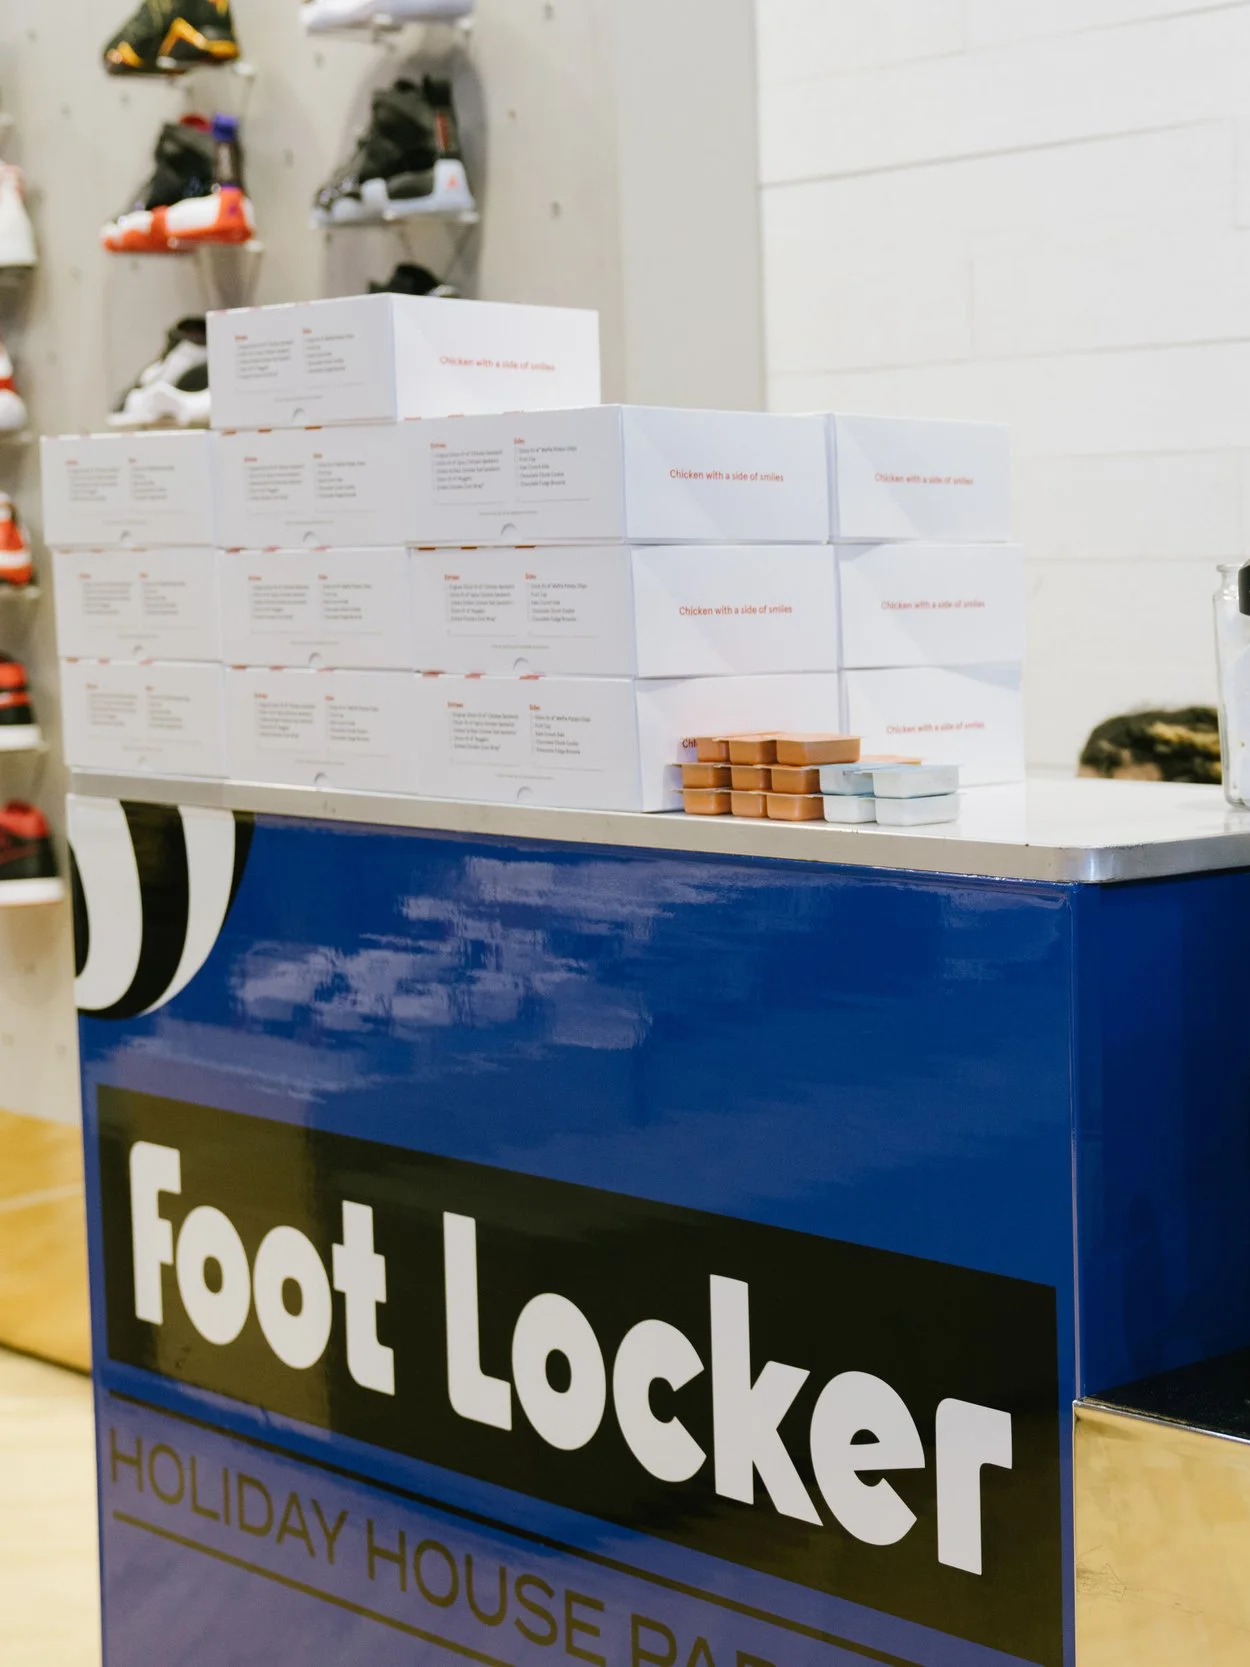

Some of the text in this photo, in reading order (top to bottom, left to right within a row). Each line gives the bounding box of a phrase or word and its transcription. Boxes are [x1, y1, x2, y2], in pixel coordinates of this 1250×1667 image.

[669, 469, 704, 480] Chicken
[706, 470, 724, 480] with
[732, 471, 748, 481] side
[750, 472, 760, 481] of
[760, 473, 784, 482] smiles
[874, 473, 904, 483] Chicken
[906, 474, 921, 484] with
[929, 475, 942, 484] side
[944, 476, 953, 484] of
[953, 476, 974, 486] smiles
[679, 606, 713, 616] Chicken
[715, 605, 732, 615] with
[741, 605, 757, 614] side
[758, 605, 767, 614] of
[769, 605, 793, 614] smiles
[881, 601, 912, 610] Chicken
[914, 601, 931, 609] with
[938, 600, 952, 609] side
[954, 600, 962, 608] of
[964, 600, 985, 608] smiles
[443, 1211, 1012, 1575] Locker
[108, 1427, 349, 1566] HOLIDAY
[366, 1518, 607, 1660] HOUSE
